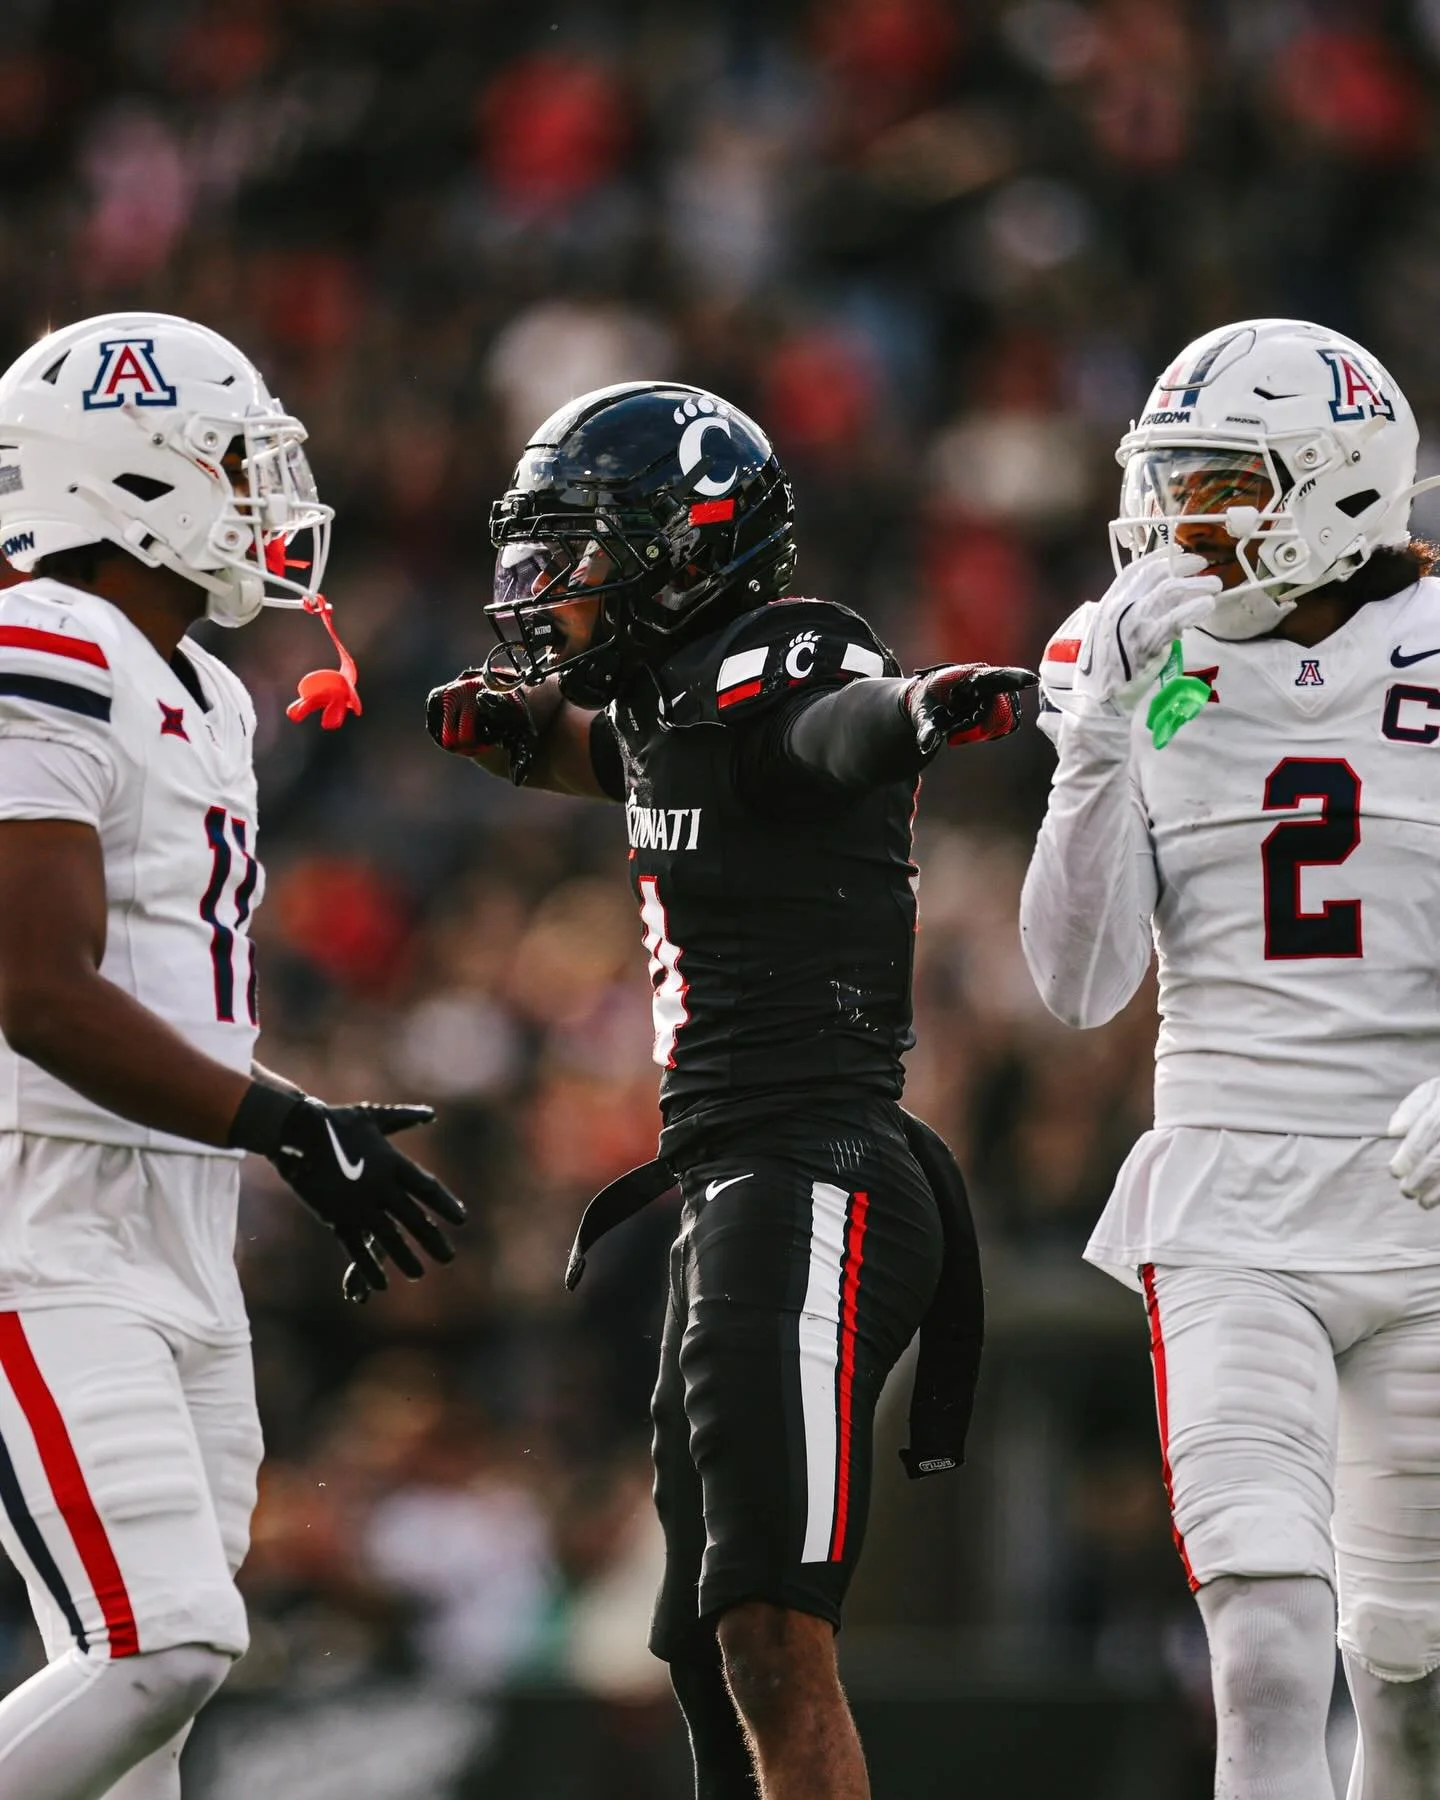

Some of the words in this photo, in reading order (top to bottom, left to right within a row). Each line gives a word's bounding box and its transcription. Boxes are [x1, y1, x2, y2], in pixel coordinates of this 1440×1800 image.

[82, 338, 177, 411] A
[1317, 348, 1397, 424] A
[679, 416, 738, 497] C
[785, 641, 818, 679] C
[1295, 660, 1324, 686] A
[1382, 682, 1440, 744] C
[1261, 756, 1363, 960] 2
